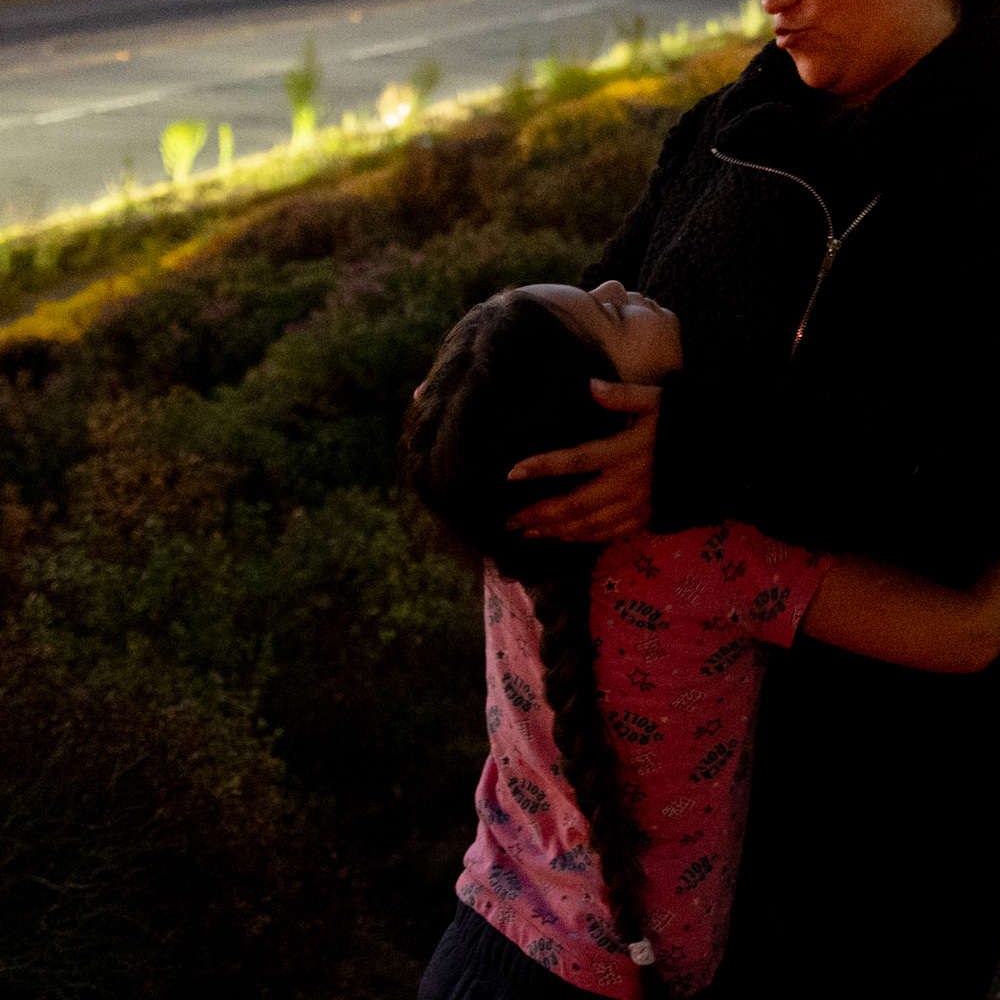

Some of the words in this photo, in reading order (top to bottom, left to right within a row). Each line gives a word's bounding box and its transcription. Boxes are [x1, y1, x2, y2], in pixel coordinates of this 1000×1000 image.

[629, 600, 662, 622] ROLL
[504, 681, 532, 713] ROCK
[614, 720, 651, 745] ROCK
[623, 710, 658, 734] ROLL
[511, 787, 540, 815] ROCK
[521, 779, 548, 801] ROLL
[587, 922, 619, 954] ROCK
